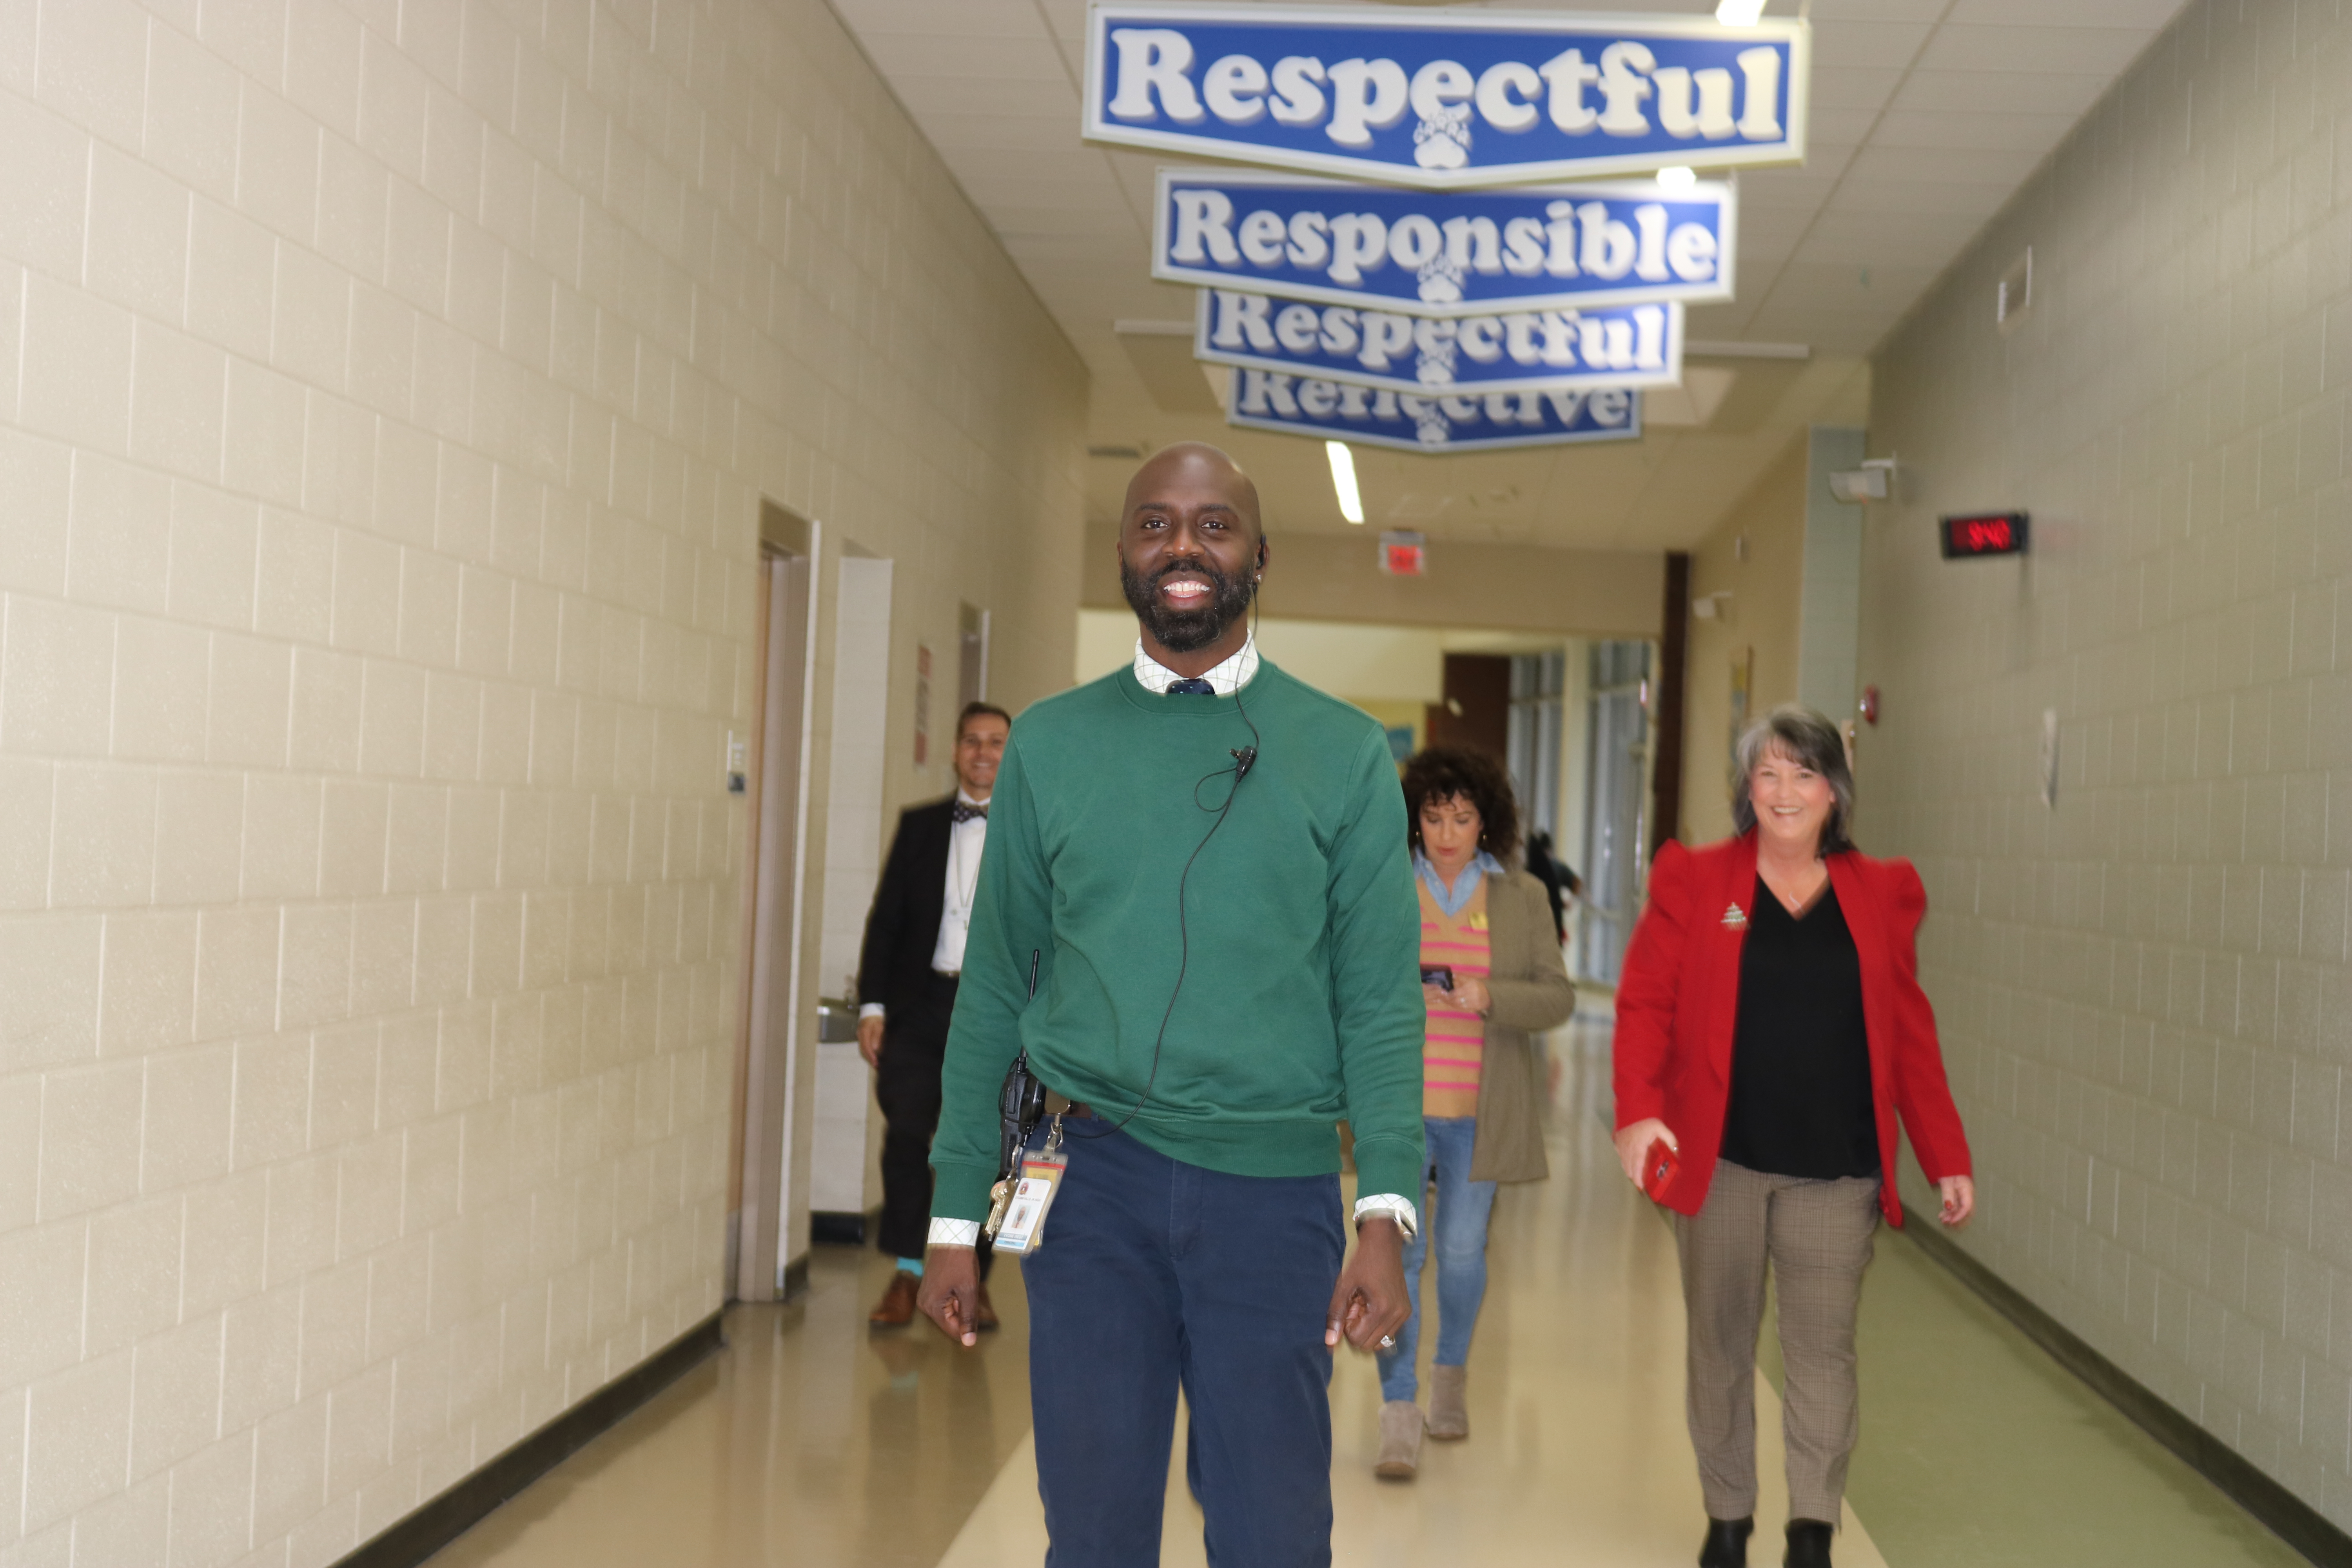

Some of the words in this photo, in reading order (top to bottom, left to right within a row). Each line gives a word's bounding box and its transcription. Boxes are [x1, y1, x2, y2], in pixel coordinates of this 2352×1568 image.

[1109, 28, 1784, 144] Respectful
[1172, 190, 1717, 283] Responsible
[1212, 289, 1665, 368] Respectful
